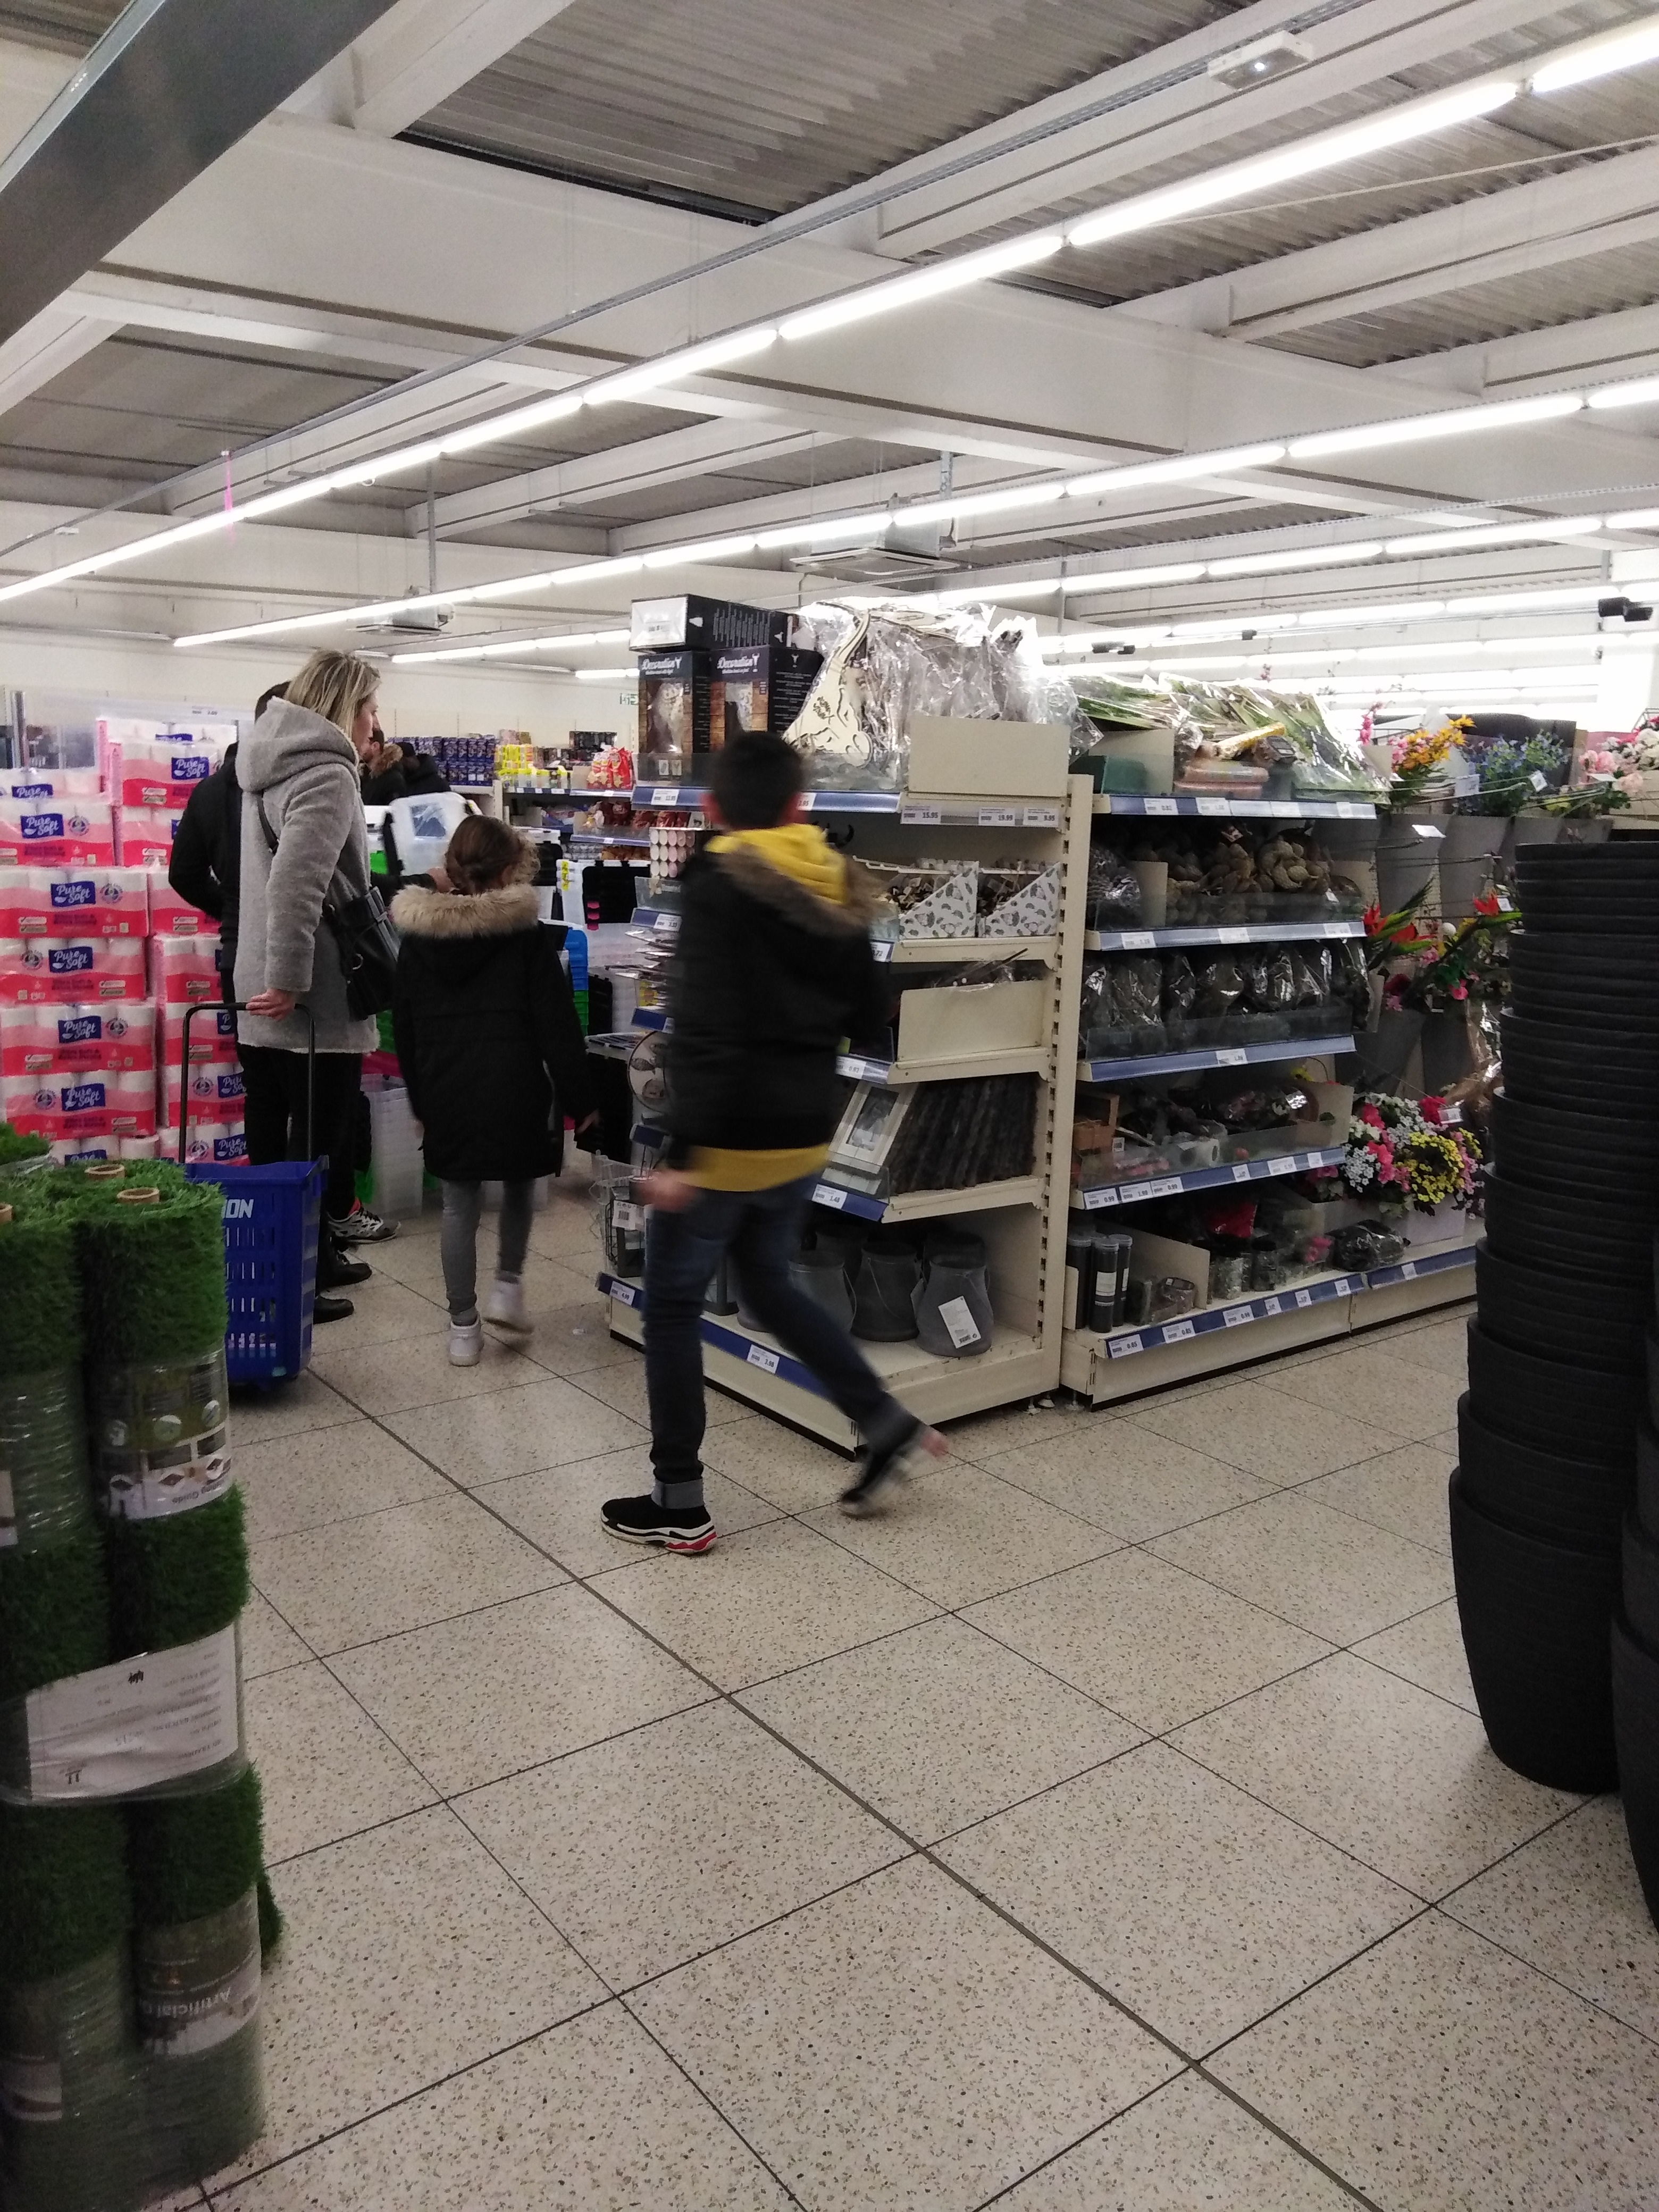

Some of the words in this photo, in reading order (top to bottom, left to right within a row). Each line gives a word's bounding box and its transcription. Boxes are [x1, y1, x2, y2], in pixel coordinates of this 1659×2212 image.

[176, 759, 197, 769] Pure
[186, 763, 206, 777] Soft
[26, 817, 51, 828] Pure
[37, 820, 58, 835] Soft
[56, 885, 82, 895] Pure
[68, 888, 91, 903] Soft
[54, 951, 80, 962] Pure
[66, 953, 88, 969] Soft
[64, 1020, 89, 1032] Pure
[74, 1023, 96, 1038] Soft
[67, 1088, 91, 1102] Pure
[78, 1091, 100, 1106] Soft
[219, 1138, 241, 1150] Pure
